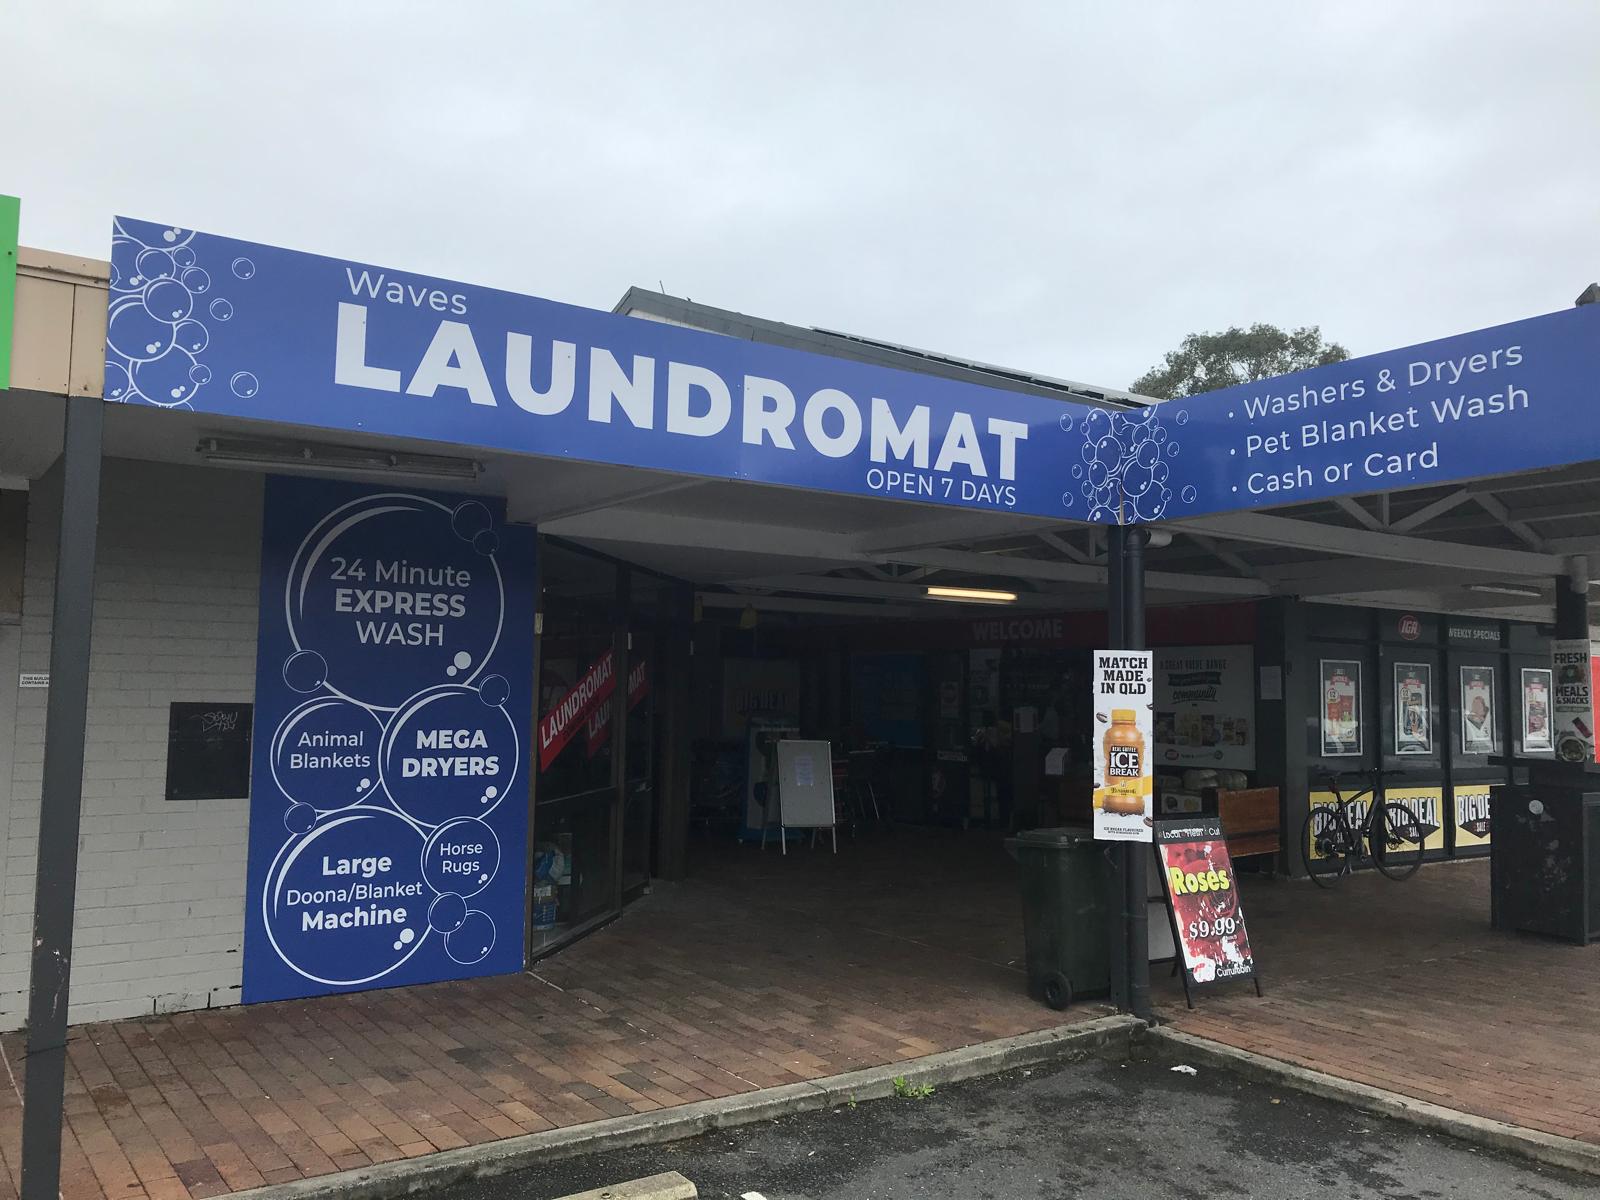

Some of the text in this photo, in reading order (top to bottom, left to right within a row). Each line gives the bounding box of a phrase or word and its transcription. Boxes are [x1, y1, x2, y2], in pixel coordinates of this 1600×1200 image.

[345, 267, 468, 315] Waves
[333, 301, 1029, 482] LAUNDROMAT
[1244, 344, 1524, 420] Washers & Dryers
[1246, 384, 1530, 458] Pet Blanket Wash
[1247, 442, 1440, 496] Cash or Card
[866, 468, 1017, 508] OPEN 7 DAYS
[330, 556, 471, 588] 24 Minute
[335, 588, 466, 618] EXPRESS
[355, 620, 444, 646] WASH
[972, 619, 1063, 641] WELCOME
[1401, 619, 1418, 634] IGA
[1473, 629, 1501, 641] SPECIALS
[1098, 656, 1148, 669] MATCH
[1554, 652, 1588, 664] FRESH
[1103, 669, 1143, 682] MADE
[1100, 682, 1146, 696] IN QLD
[1555, 686, 1589, 697] MEALS
[1563, 696, 1589, 705] SNACKS
[541, 653, 613, 750] LAUNDROMAT
[298, 730, 365, 747] Animal
[415, 729, 488, 750] MEGA
[290, 752, 371, 770] Blankets
[402, 755, 500, 779] DRYERS
[1110, 752, 1139, 768] ICE
[1109, 768, 1139, 776] BREAK
[1456, 794, 1477, 826] BIG
[439, 841, 483, 857] Horse
[322, 855, 392, 880] Large
[442, 858, 480, 876] Rugs
[1168, 866, 1230, 896] Roses
[285, 881, 423, 907] Doona/Blanket
[301, 904, 407, 932] Machine
[1188, 917, 1236, 940] $9.99
